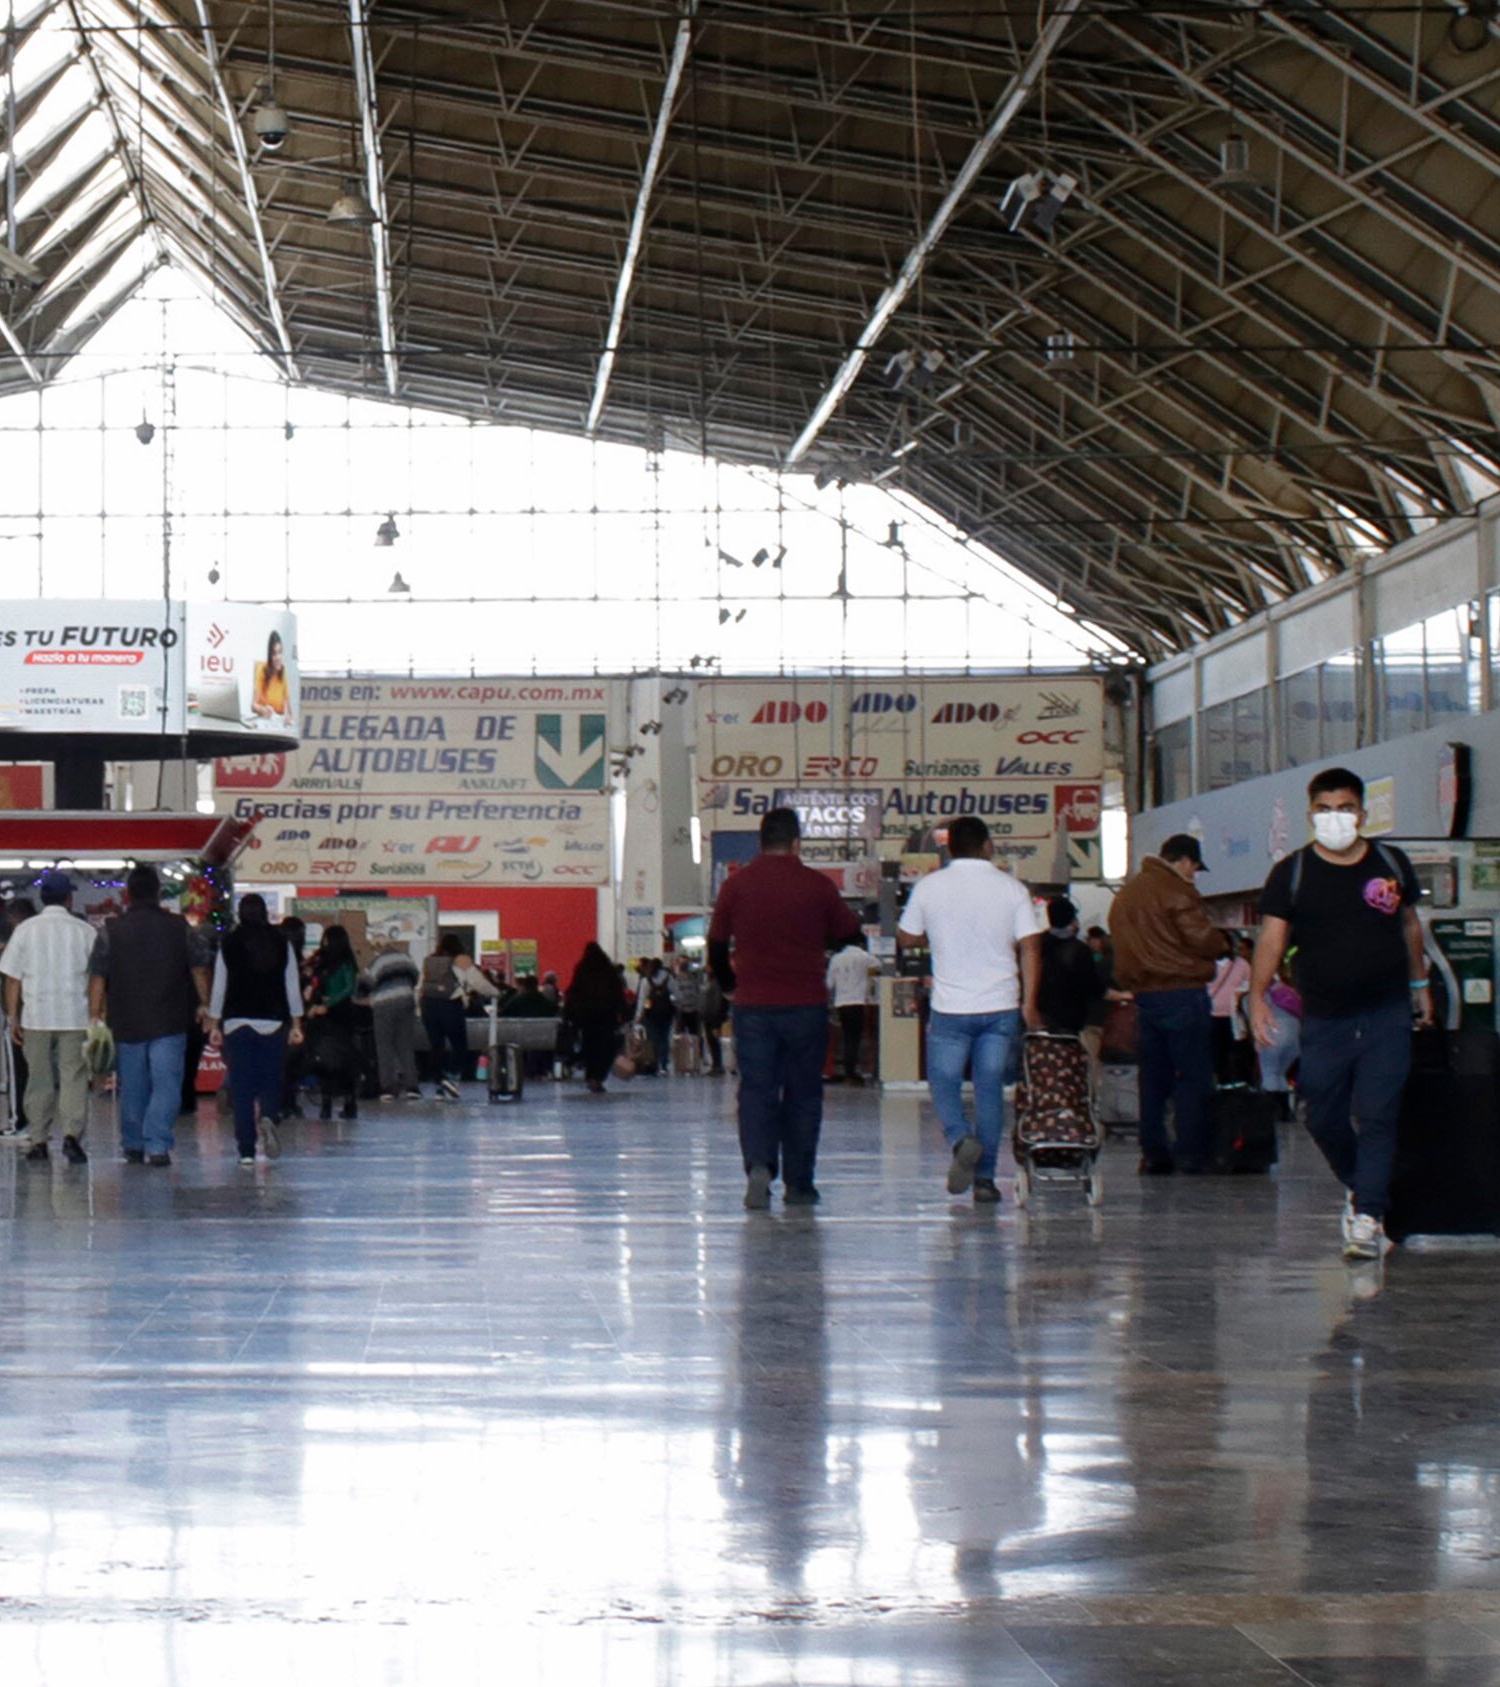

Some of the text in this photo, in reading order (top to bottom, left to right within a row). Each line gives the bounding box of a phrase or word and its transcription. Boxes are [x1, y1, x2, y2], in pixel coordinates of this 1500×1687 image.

[23, 630, 55, 647] TU
[60, 626, 178, 648] FUTURO
[24, 687, 57, 695] PREPA
[24, 697, 105, 706] LICENCIATURAS
[350, 686, 381, 701] en:
[391, 685, 605, 704] www.capu.com.mx
[749, 701, 828, 724] ADO
[930, 702, 1000, 723] ADO
[850, 692, 917, 714] ADO
[301, 714, 518, 741] LLEGADA DE
[307, 747, 498, 774] AUTOBUSES
[710, 754, 783, 777] ORO
[903, 758, 981, 777] Surianos
[289, 777, 528, 790] ARRIVALS ANKUNFT
[234, 797, 582, 824] Gracias por su Preferencia
[883, 786, 1050, 817] Autobuses
[796, 806, 868, 823] TACOS
[260, 861, 298, 874] ORO
